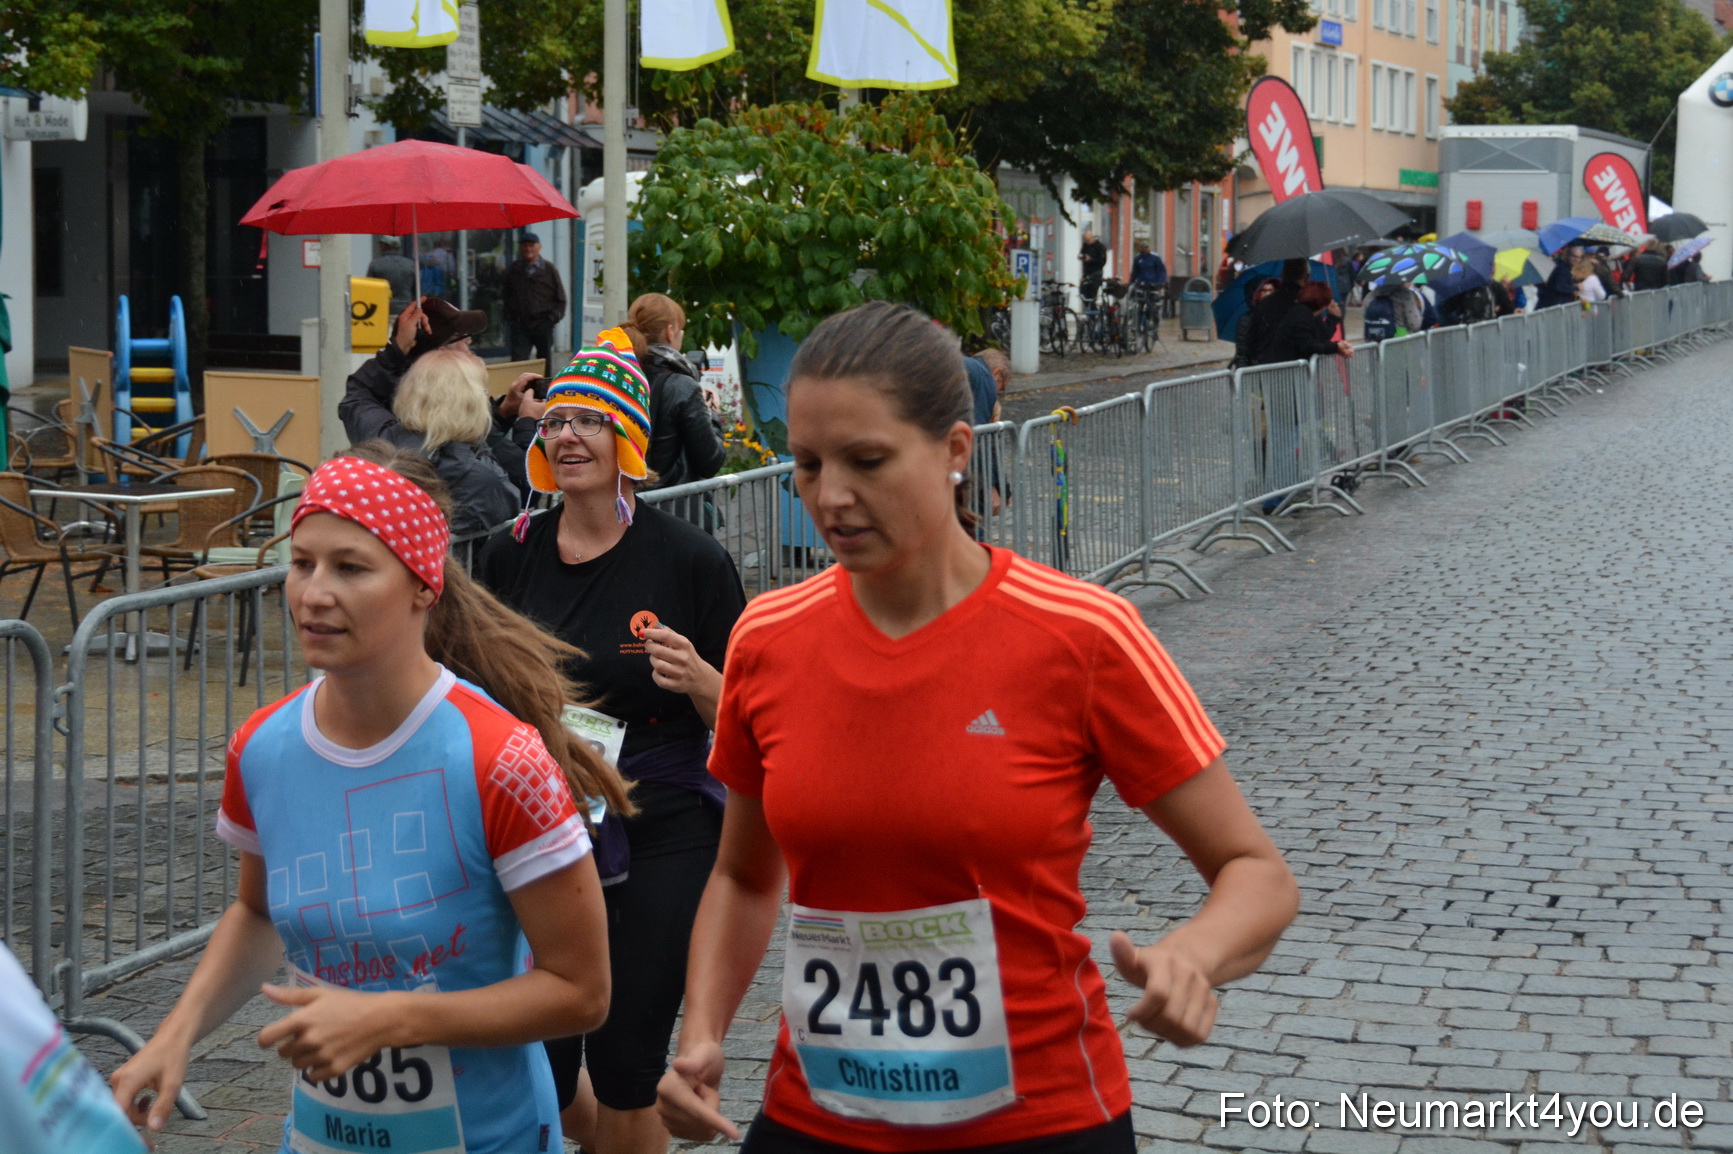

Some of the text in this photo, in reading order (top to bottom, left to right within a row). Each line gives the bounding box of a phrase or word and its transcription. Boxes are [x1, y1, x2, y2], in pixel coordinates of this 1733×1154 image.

[565, 709, 614, 735] OCK
[965, 724, 1005, 736] adidas
[791, 930, 852, 946] NeuerMarkt
[859, 912, 973, 942] BOCK
[804, 957, 981, 1038] 2483
[837, 1057, 960, 1092] Christina
[325, 1113, 392, 1148] Maria
